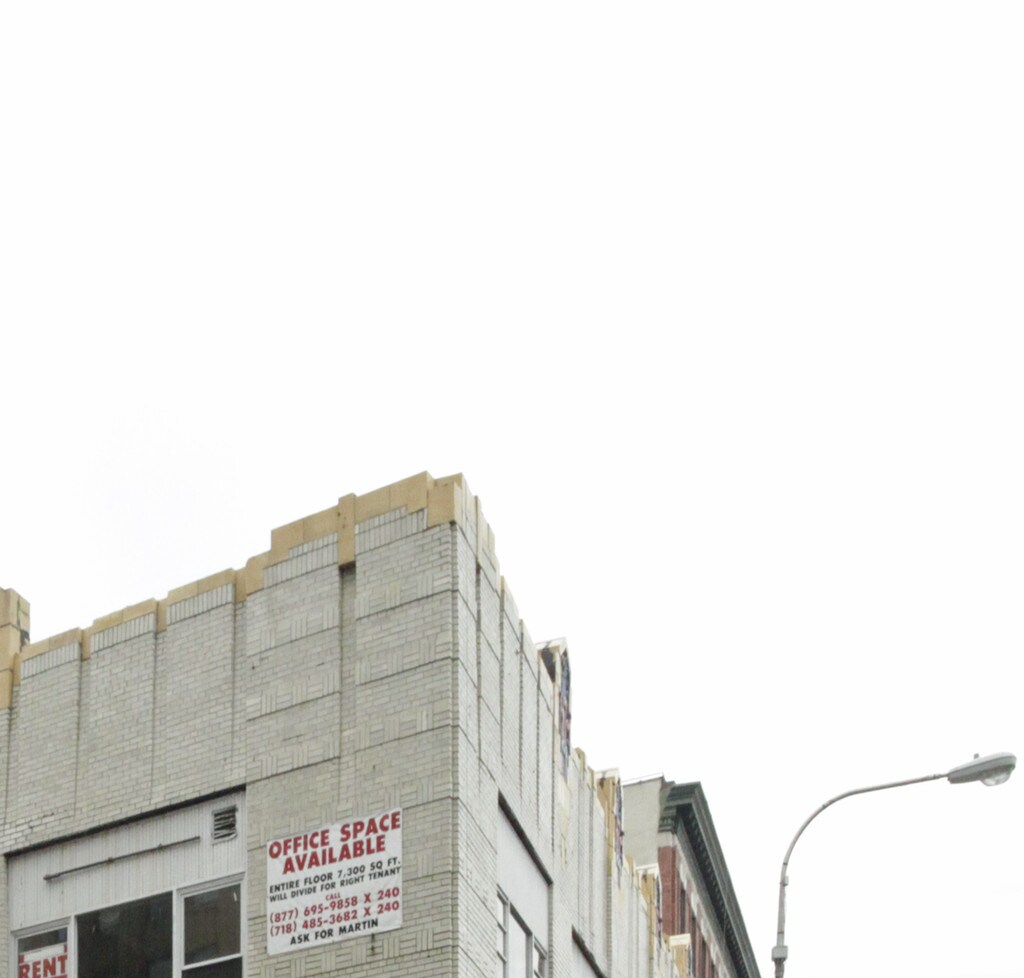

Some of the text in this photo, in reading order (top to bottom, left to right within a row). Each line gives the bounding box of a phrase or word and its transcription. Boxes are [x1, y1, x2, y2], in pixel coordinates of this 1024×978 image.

[268, 811, 401, 859] OFFICE SPACE
[282, 835, 386, 875] AVAILABLE
[269, 879, 300, 894] ENTIRE
[304, 872, 333, 887] FLOOR
[337, 865, 366, 878] 7,300
[370, 860, 383, 871] SQ
[269, 867, 401, 903] WILL DIVIDE FOR RIGHT TENANT
[269, 887, 400, 924] (877) 695-9858 X 240
[326, 892, 341, 901] CALL
[270, 900, 400, 937] (718) 485-3682 X 240
[290, 919, 379, 945] ASK FOR MARTIN
